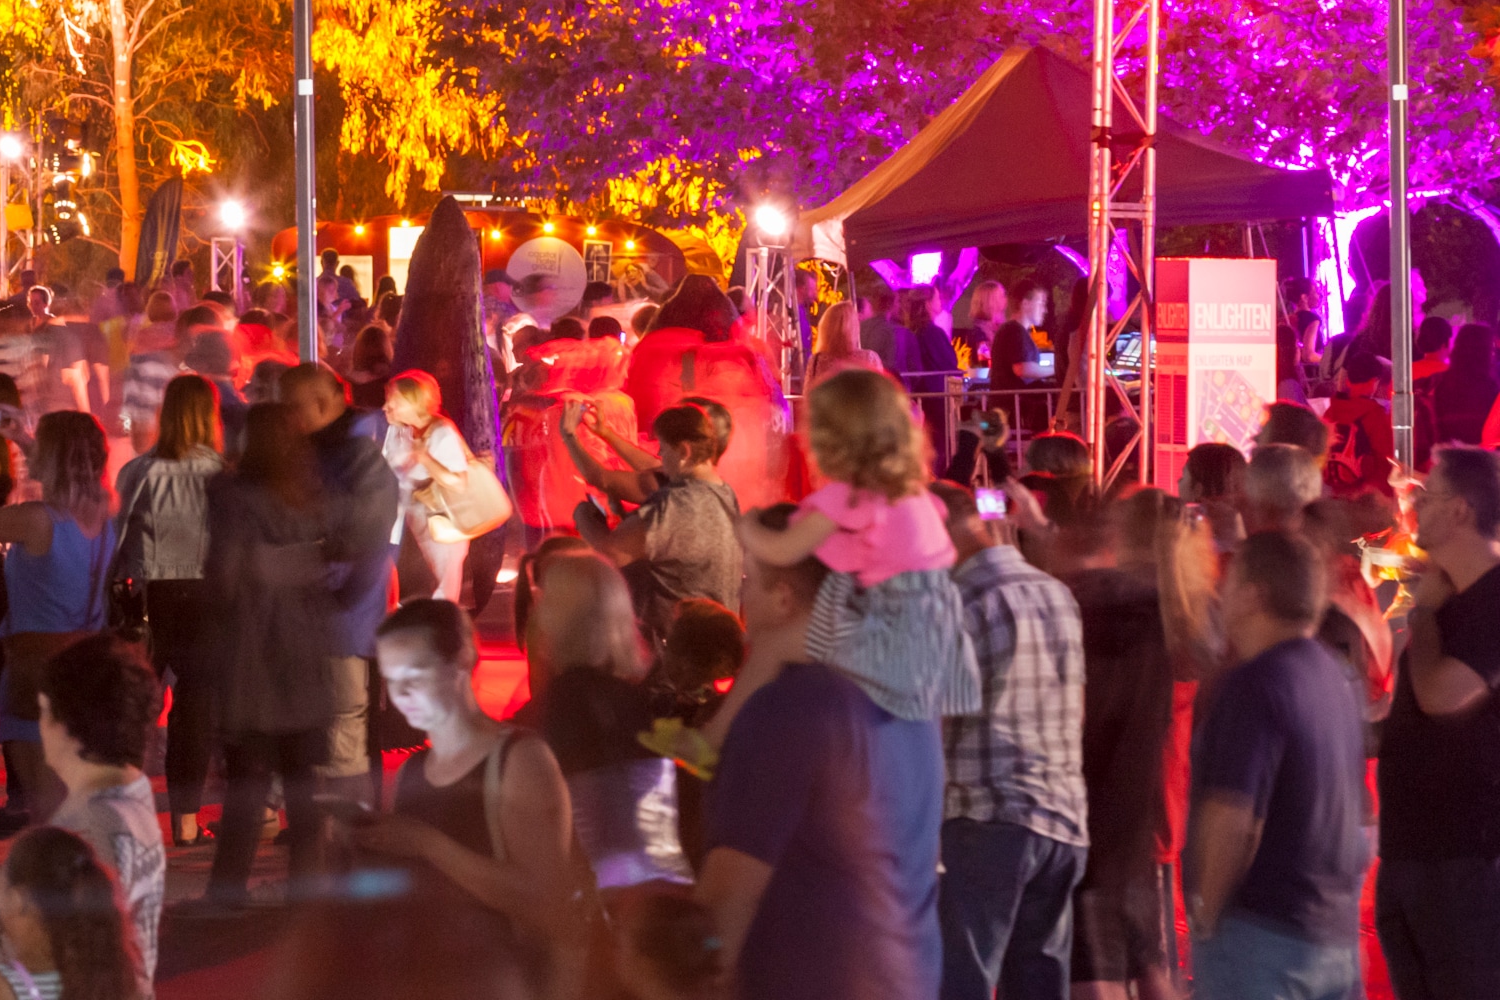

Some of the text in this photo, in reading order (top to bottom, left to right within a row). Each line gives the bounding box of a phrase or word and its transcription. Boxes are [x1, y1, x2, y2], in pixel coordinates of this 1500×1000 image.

[1194, 302, 1271, 330] ENLIGHTEN
[1195, 354, 1234, 367] ENLIGHTEN
[1236, 354, 1253, 366] MAP
